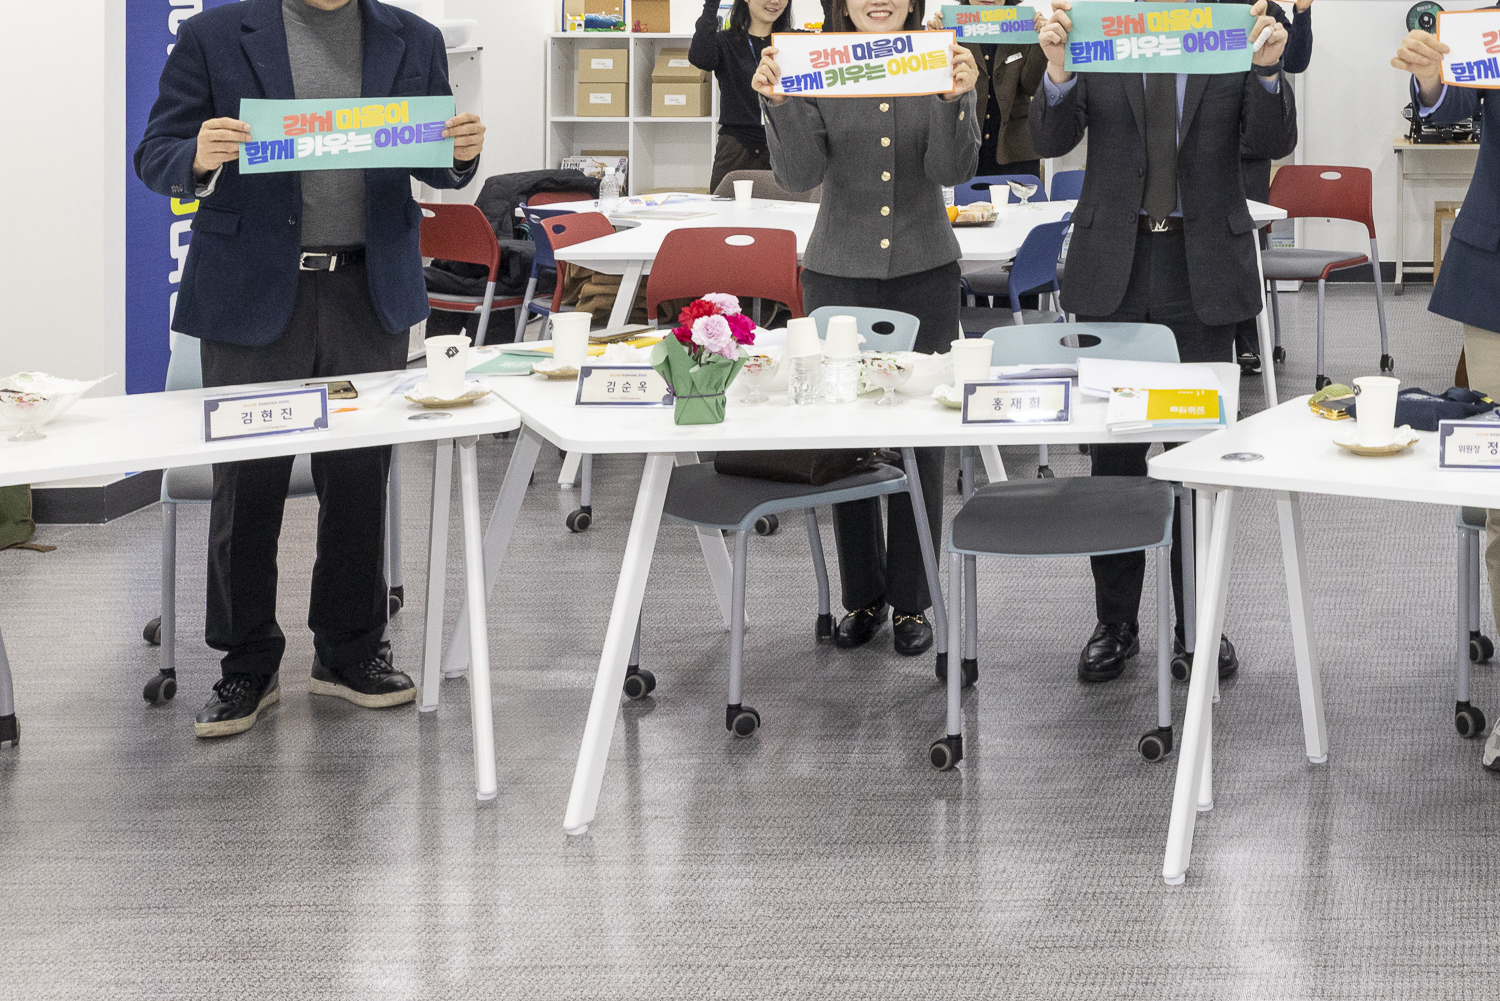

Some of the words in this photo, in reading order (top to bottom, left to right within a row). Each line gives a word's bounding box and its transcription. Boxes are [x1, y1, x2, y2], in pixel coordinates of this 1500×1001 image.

[956, 11, 980, 24] 강서
[981, 8, 1017, 22] 마을이
[964, 23, 1000, 37] 키우는
[1000, 19, 1035, 33] 아이들
[1101, 12, 1145, 36] 강서
[1147, 7, 1213, 32] 마을이
[809, 45, 851, 69] 강서
[852, 35, 913, 61] 마을이
[1070, 40, 1114, 64] 함께
[1116, 34, 1182, 60] 키우는
[1183, 28, 1248, 53] 아이들
[781, 70, 824, 93] 함께
[825, 62, 886, 88] 키우는
[887, 50, 948, 77] 아이들
[1451, 57, 1500, 82] 함께
[283, 110, 333, 136] 강서
[336, 101, 409, 129] 마을이
[245, 138, 295, 166] 함께
[298, 131, 372, 158] 키우는
[374, 120, 446, 148] 아이들
[1458, 444, 1480, 454] 위원장
